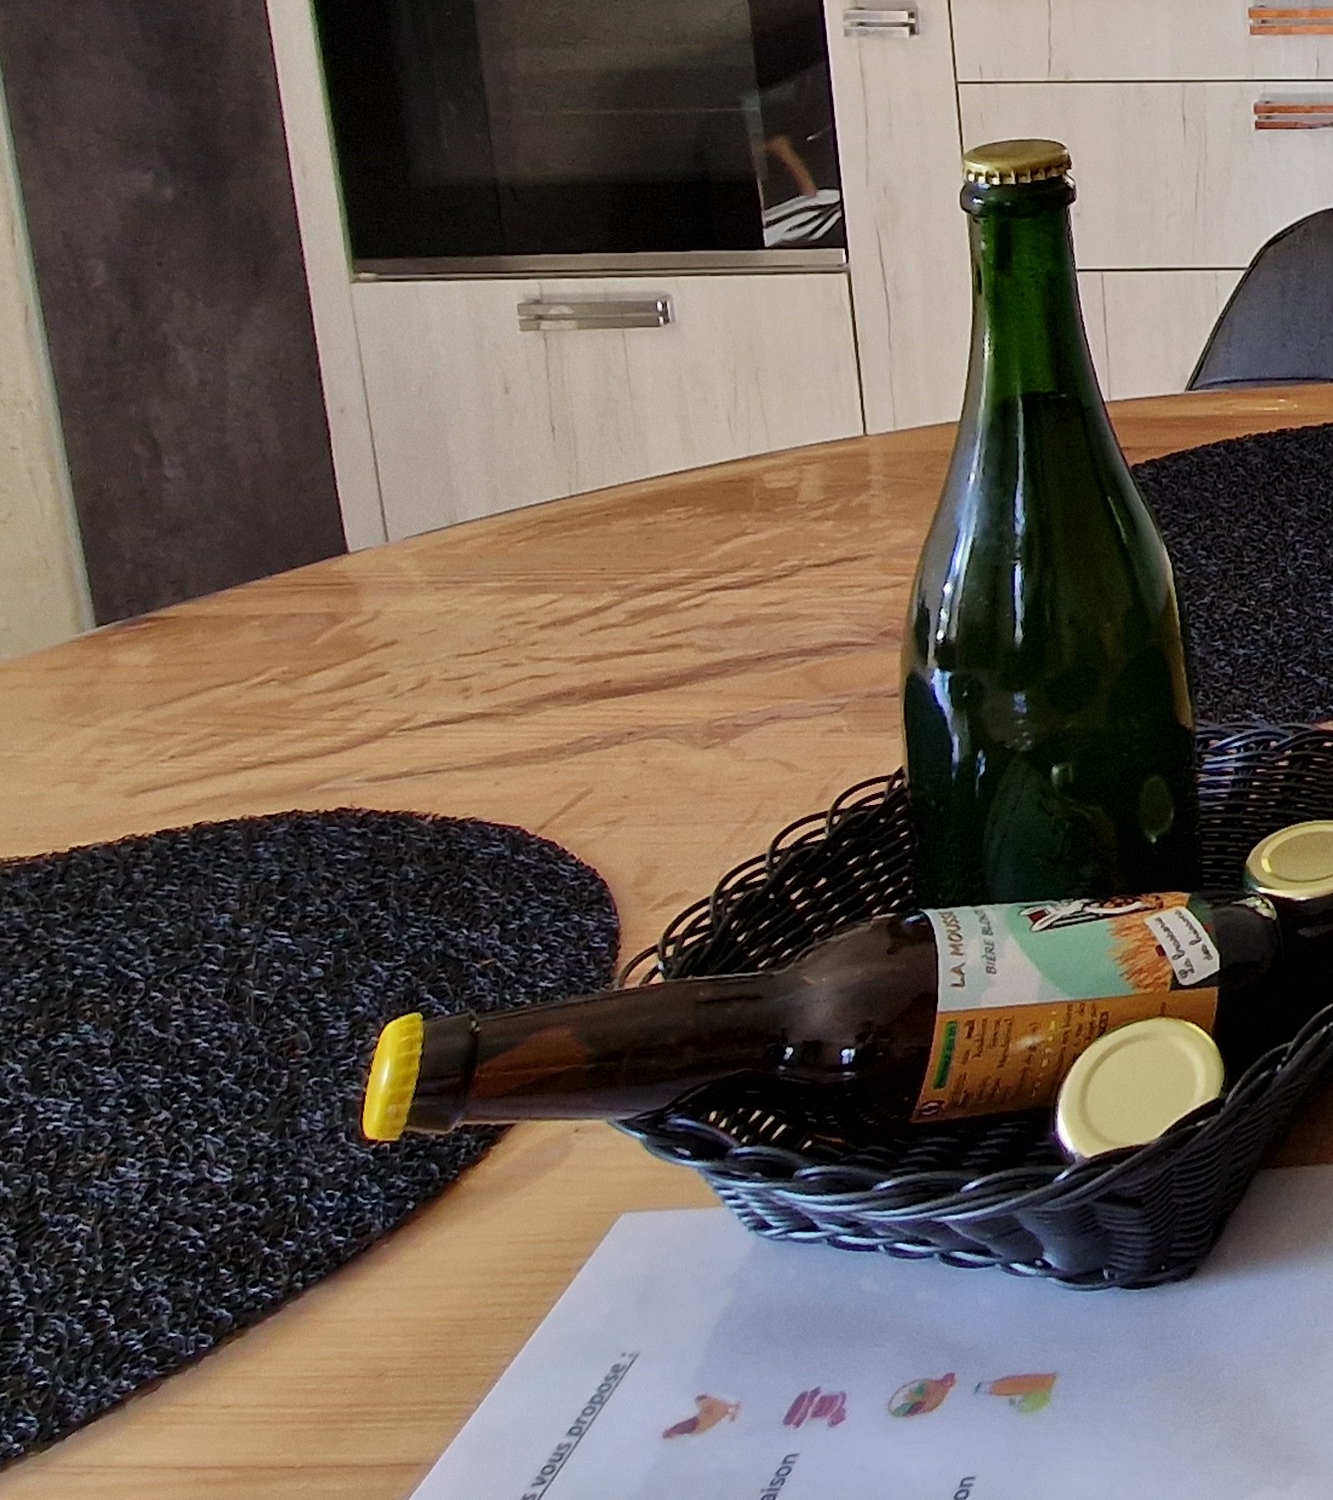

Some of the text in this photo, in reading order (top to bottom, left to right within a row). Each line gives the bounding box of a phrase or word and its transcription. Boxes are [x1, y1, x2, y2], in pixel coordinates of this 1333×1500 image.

[949, 962, 967, 988] LA
[981, 938, 998, 975] BIÈRE
[531, 1441, 572, 1488] vous
[567, 1362, 629, 1438] propose
